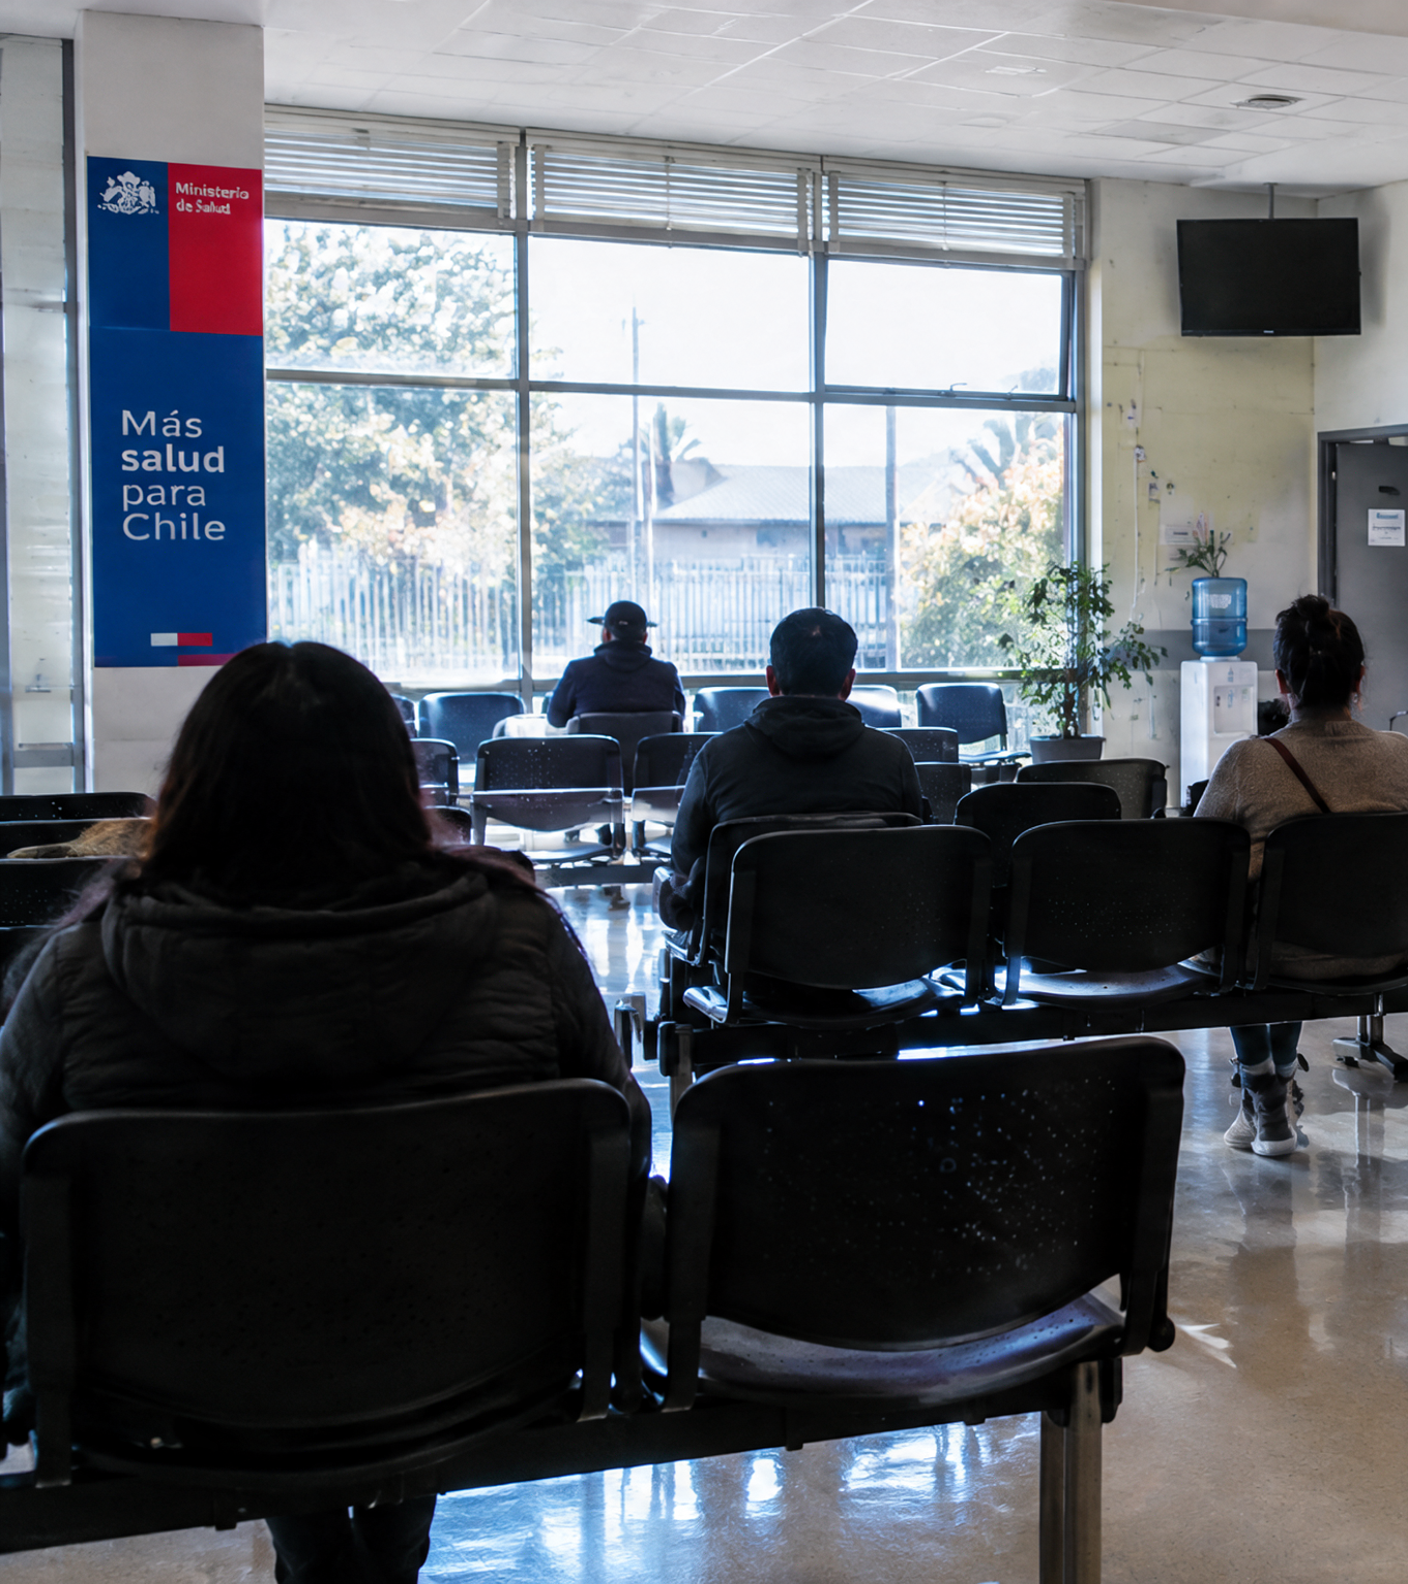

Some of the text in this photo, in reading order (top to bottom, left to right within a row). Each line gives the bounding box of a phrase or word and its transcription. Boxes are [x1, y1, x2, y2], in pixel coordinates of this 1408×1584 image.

[176, 182, 249, 200] Ministerio
[176, 198, 231, 215] de Salud
[121, 409, 202, 438] Más
[121, 443, 225, 473] salud
[122, 482, 206, 511] para
[122, 513, 226, 541] Chile
